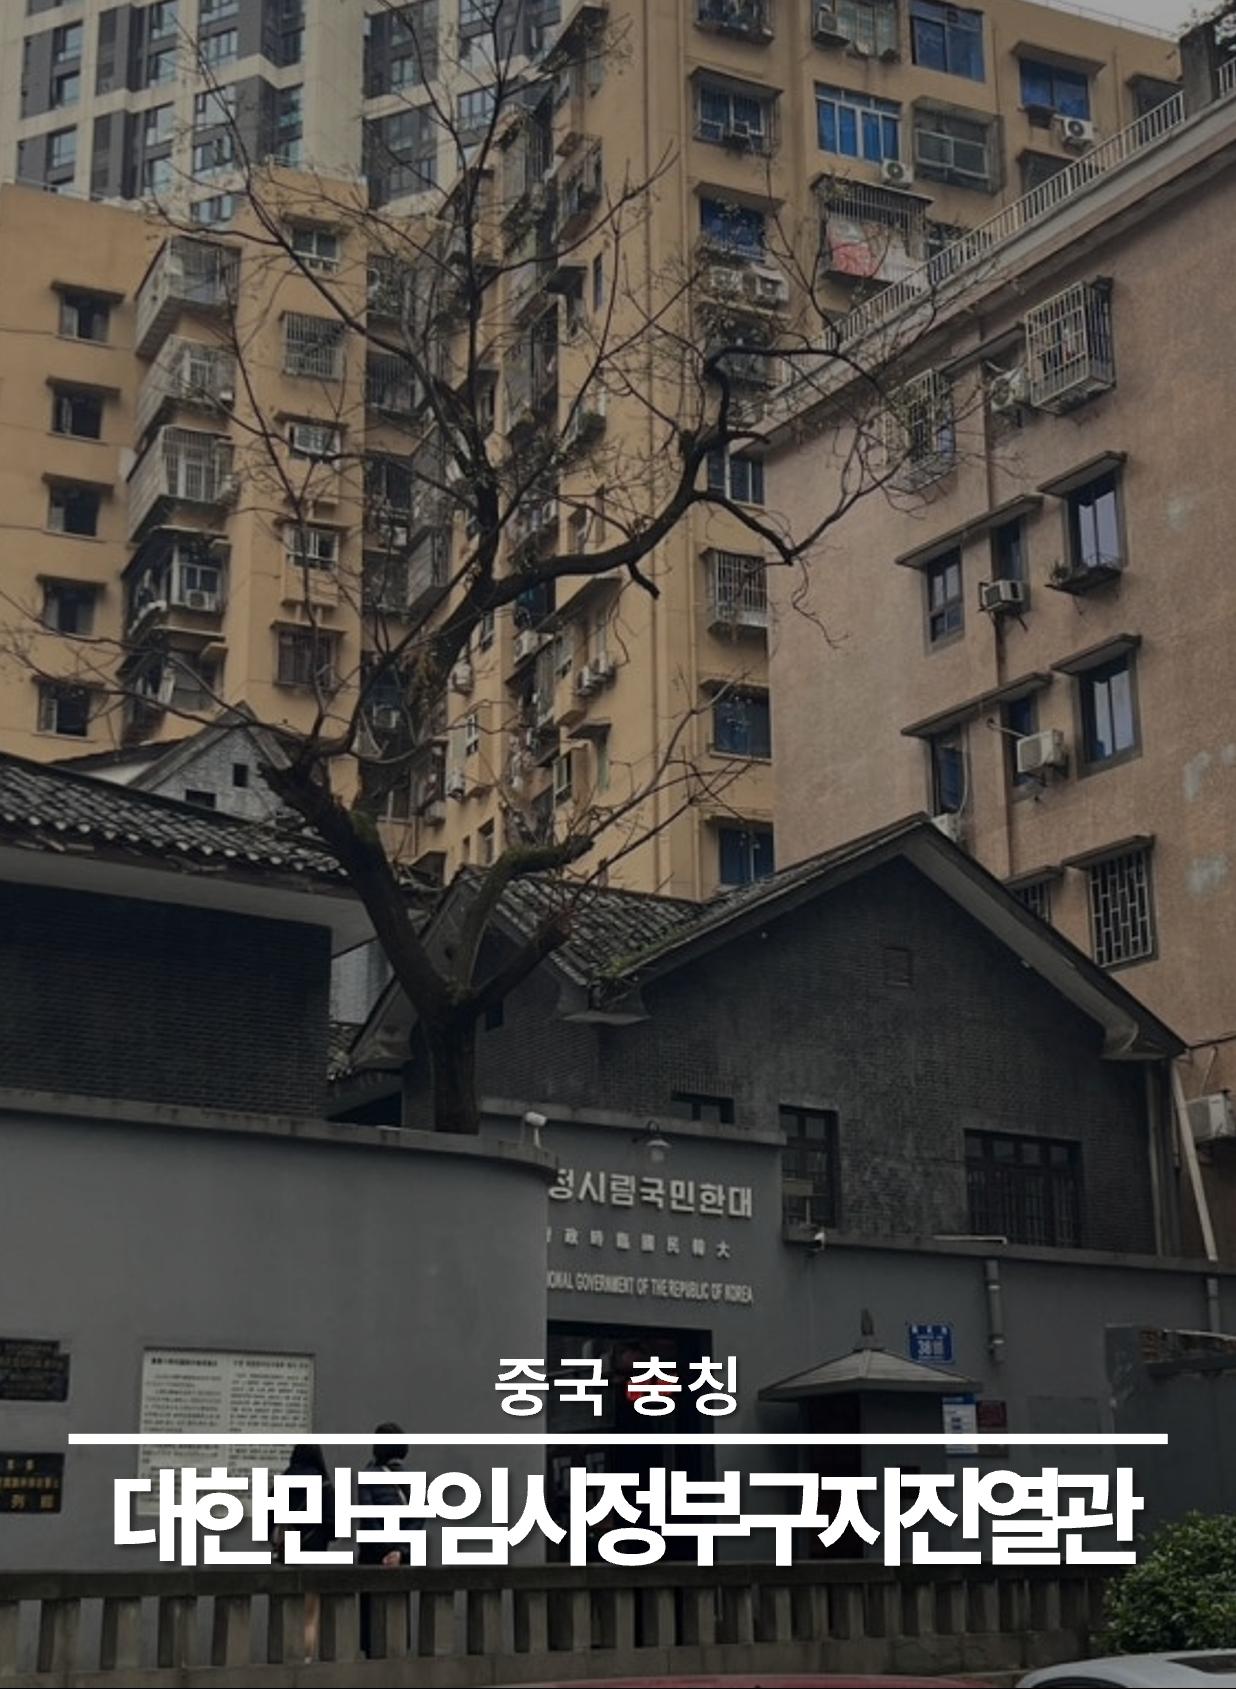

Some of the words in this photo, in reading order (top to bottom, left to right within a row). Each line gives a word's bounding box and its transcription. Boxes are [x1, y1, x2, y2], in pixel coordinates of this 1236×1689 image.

[575, 1272, 633, 1295] GOVERNMENT
[637, 1278, 649, 1295] OF
[651, 1279, 668, 1297] THE
[668, 1280, 709, 1300] REPUBLIC
[711, 1283, 723, 1301] OF
[725, 1284, 752, 1304] KOREA
